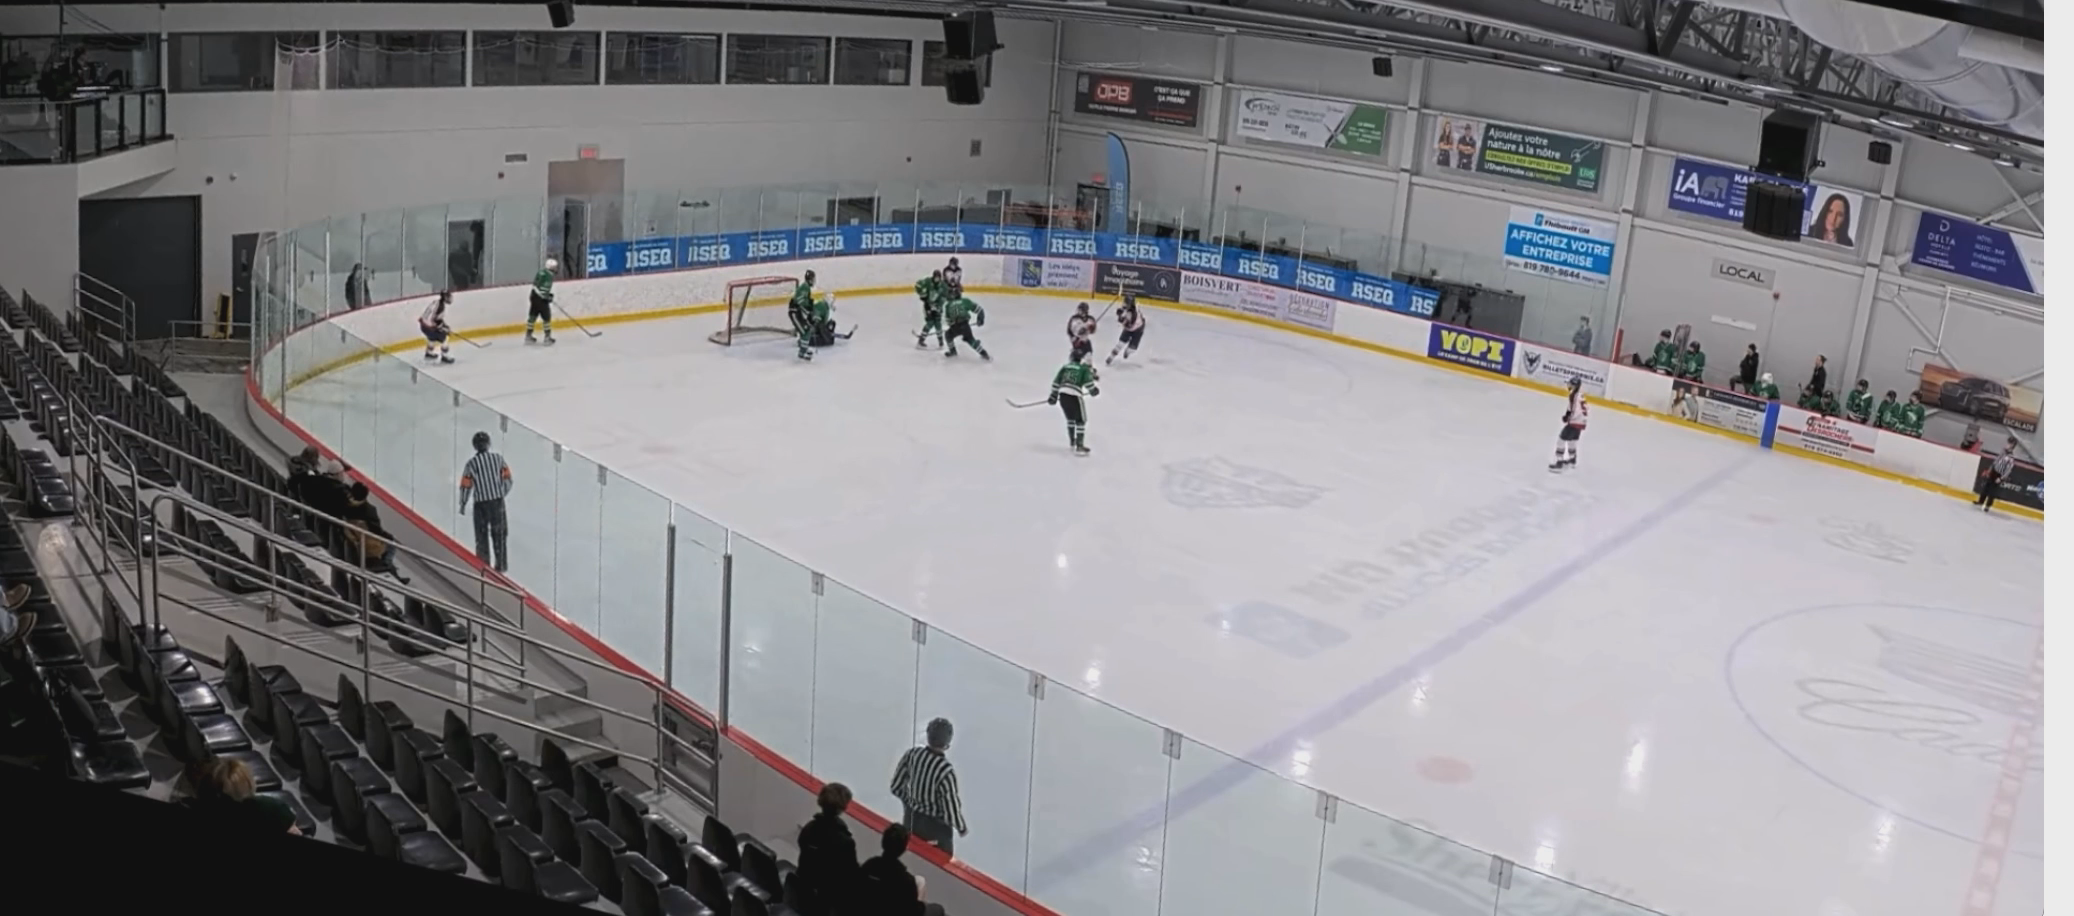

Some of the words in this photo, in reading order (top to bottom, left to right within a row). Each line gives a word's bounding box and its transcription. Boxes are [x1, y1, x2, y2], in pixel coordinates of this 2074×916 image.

[1488, 127, 1522, 141] Ajoutez
[1524, 134, 1548, 146] votre
[1487, 140, 1516, 151] nature
[1518, 142, 1524, 153] à
[1526, 143, 1534, 154] la
[1536, 146, 1561, 159] nôtre
[1674, 168, 1699, 195] iA
[1673, 193, 1696, 203] Groupe
[1697, 197, 1725, 208] financier
[747, 239, 789, 258] RSEQ
[804, 235, 845, 253] RSEQ
[861, 232, 903, 249] RSEQ
[920, 232, 966, 248] RSEQ
[982, 233, 1032, 251] RSEQ
[1051, 237, 1098, 255] RSEQ
[1510, 228, 1568, 249] AFFICHEZ
[1570, 239, 1611, 257] VOTRE
[1927, 232, 1956, 246] DELTA
[625, 248, 672, 268] RSEQ
[1115, 242, 1161, 261] RSEQ
[1180, 248, 1222, 269] RSEQ
[1521, 244, 1594, 268] ENTREPRISE
[588, 254, 608, 272] EQ
[1237, 258, 1280, 280] RSEQ
[1523, 261, 1537, 271] 819
[1183, 273, 1241, 294] BOISVERT
[1296, 268, 1336, 292] RSEQ
[1719, 264, 1765, 284] LOCAL
[1351, 281, 1395, 306] RSEQ
[1410, 294, 1437, 316] RS
[2003, 417, 2035, 431] ESCALADE
